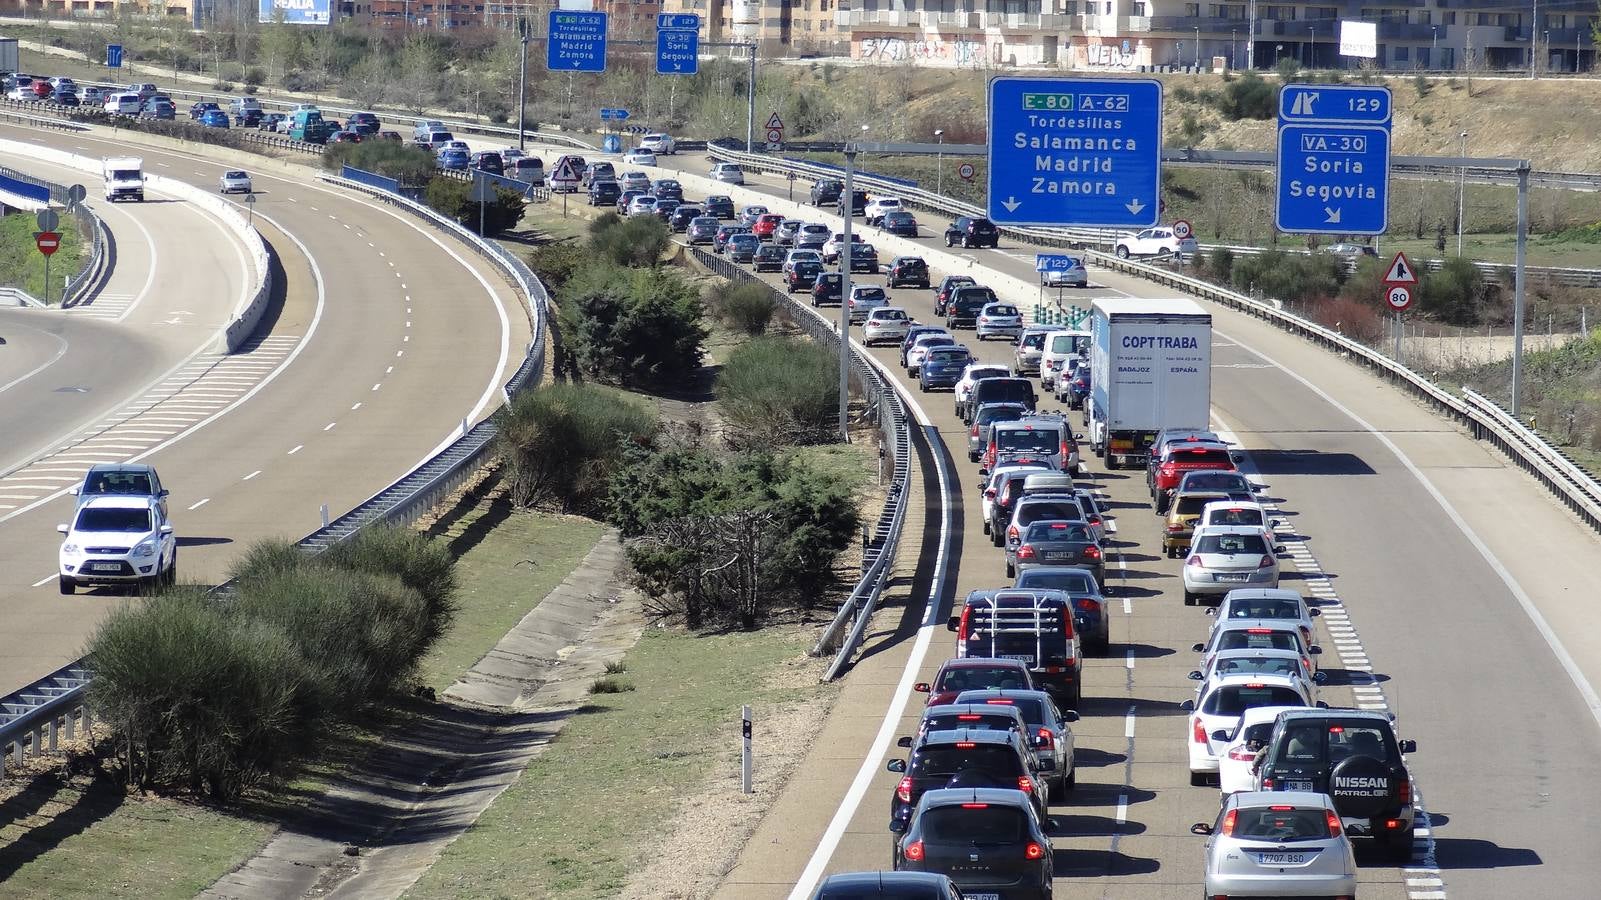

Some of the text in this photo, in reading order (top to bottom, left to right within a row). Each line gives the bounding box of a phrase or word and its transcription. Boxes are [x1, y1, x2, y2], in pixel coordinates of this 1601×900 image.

[553, 32, 603, 40] Salamanca
[561, 42, 593, 50] Madrid
[667, 42, 688, 50] Soria
[560, 51, 594, 59] Zamora
[661, 52, 694, 61] Segovia
[1025, 95, 1127, 110] E-80 A-62
[1348, 98, 1380, 112] 129
[1028, 115, 1122, 129] Tordesillas
[1014, 132, 1136, 151] Salamanca
[1035, 155, 1112, 173] Madrid
[1304, 156, 1363, 174] Soria
[1031, 177, 1116, 195] Zamora
[1289, 180, 1376, 202] Segovia
[1176, 226, 1188, 234] 60
[1051, 259, 1068, 268] 129
[1391, 293, 1407, 302] 80
[1335, 776, 1388, 788] NISSAN
[1264, 854, 1285, 863] 7707
